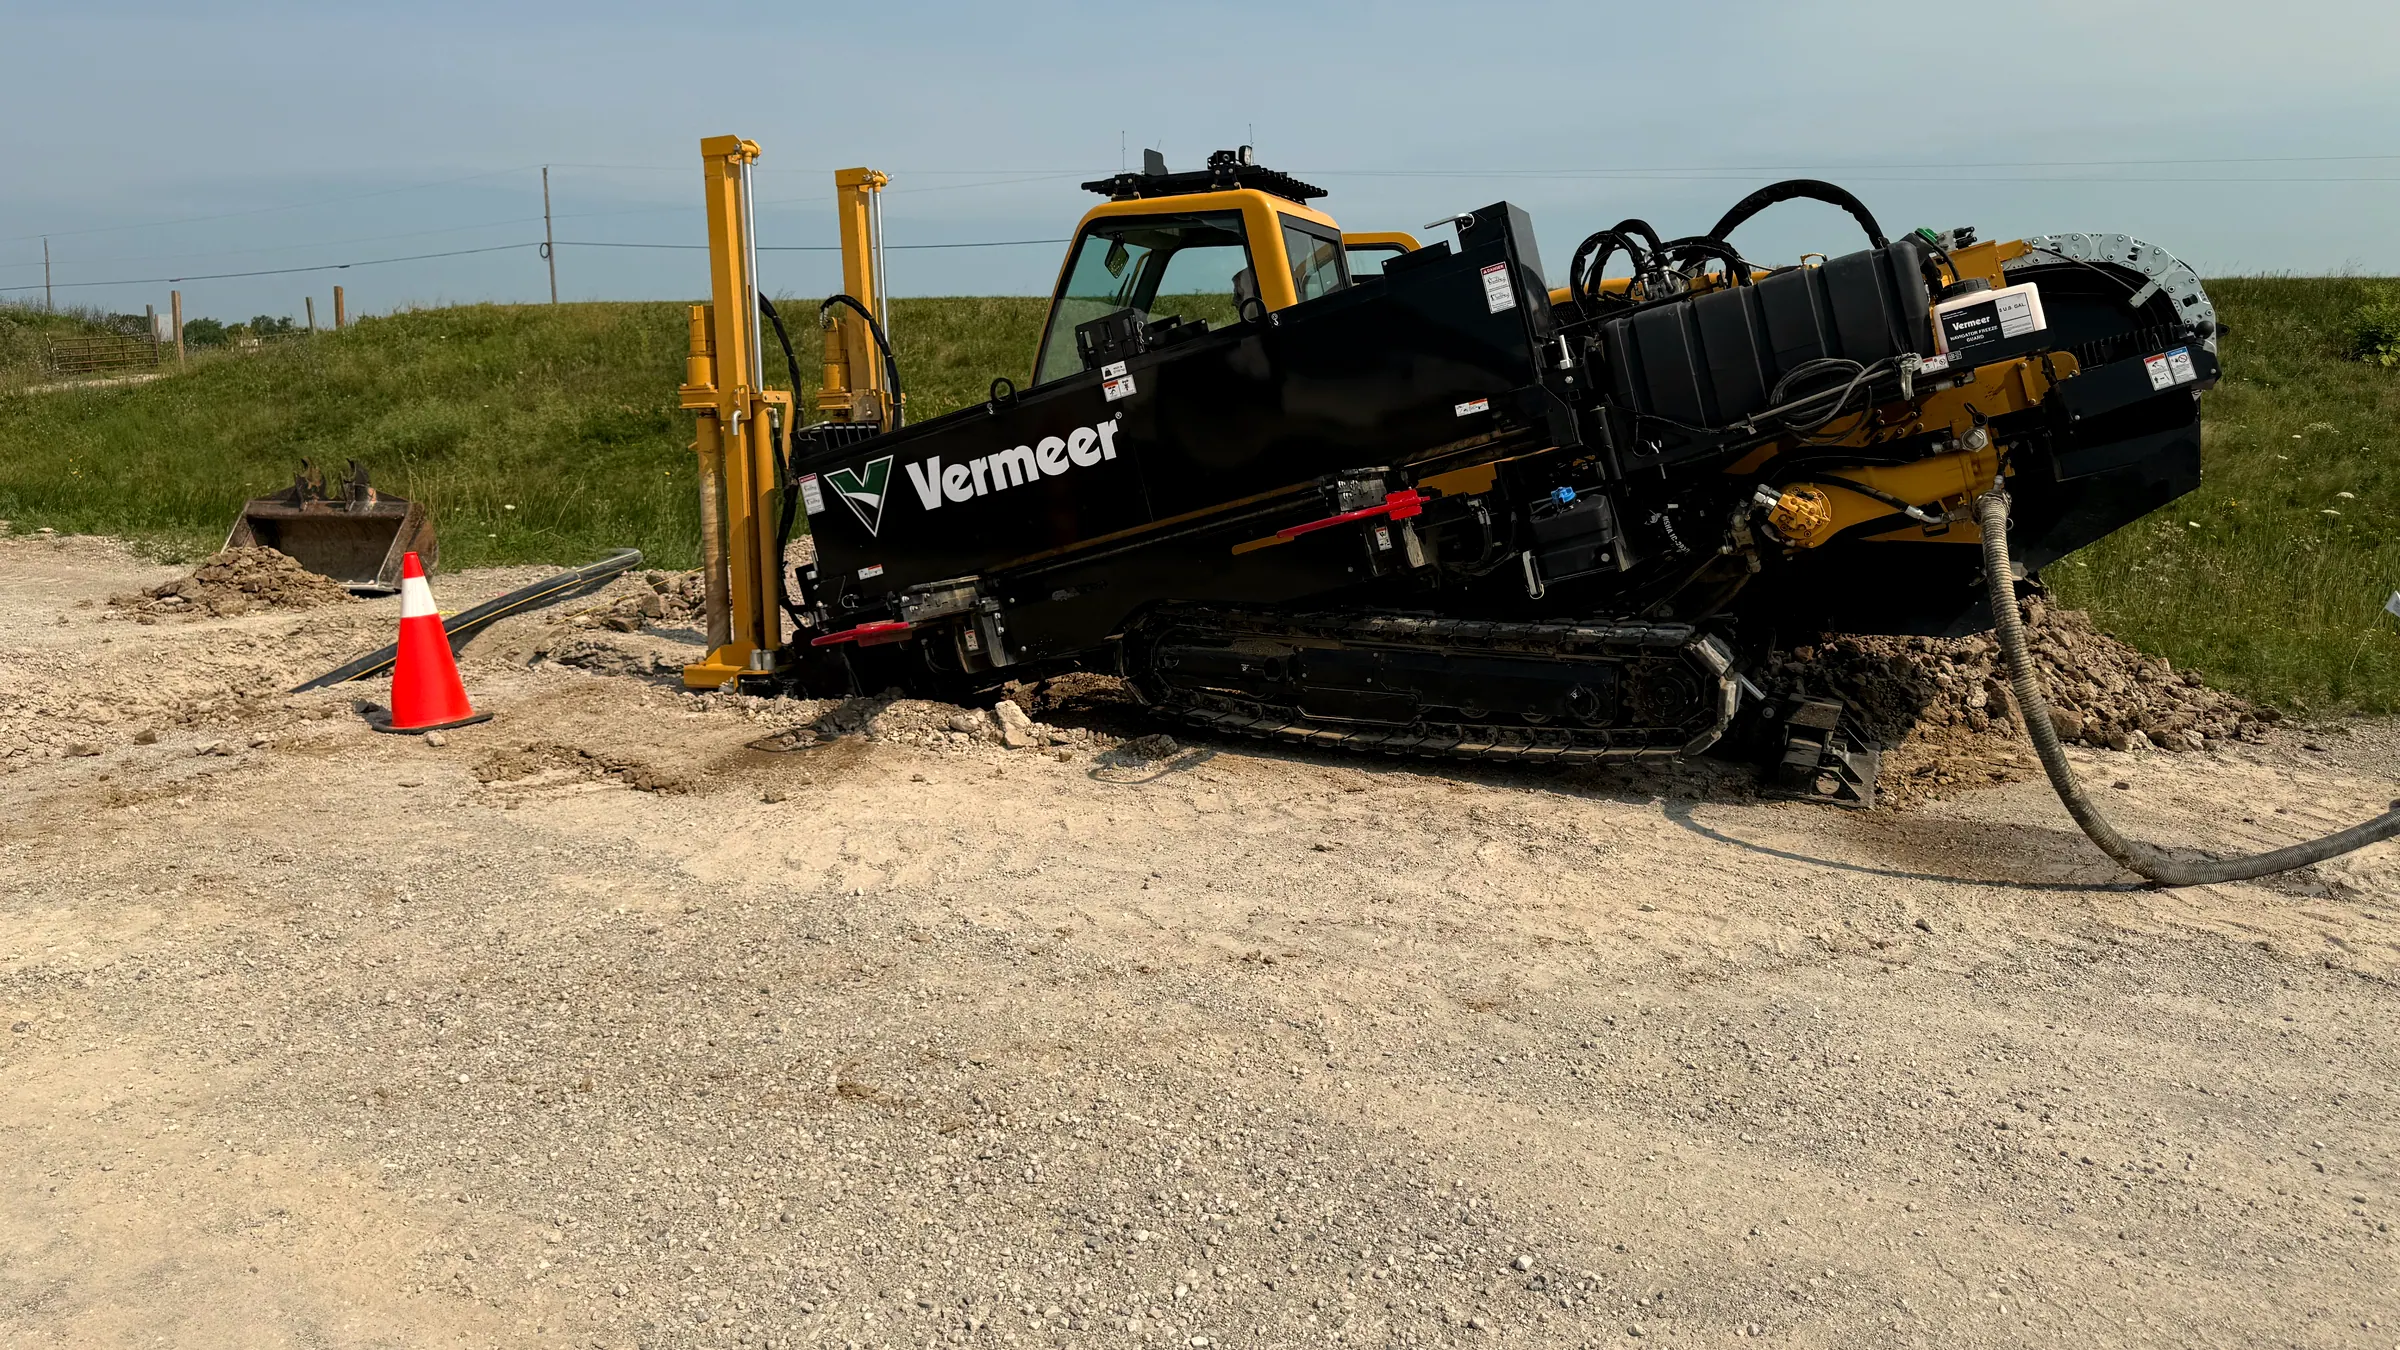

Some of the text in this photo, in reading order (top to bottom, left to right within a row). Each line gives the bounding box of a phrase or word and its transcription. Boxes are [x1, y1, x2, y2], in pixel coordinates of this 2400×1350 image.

[1952, 316, 1991, 331] Vermeer
[1950, 330, 1978, 341] NAVIGATOR
[1978, 325, 1999, 335] FREEZE
[1966, 334, 1985, 343] GUARD
[905, 419, 1119, 511] Vermeer
